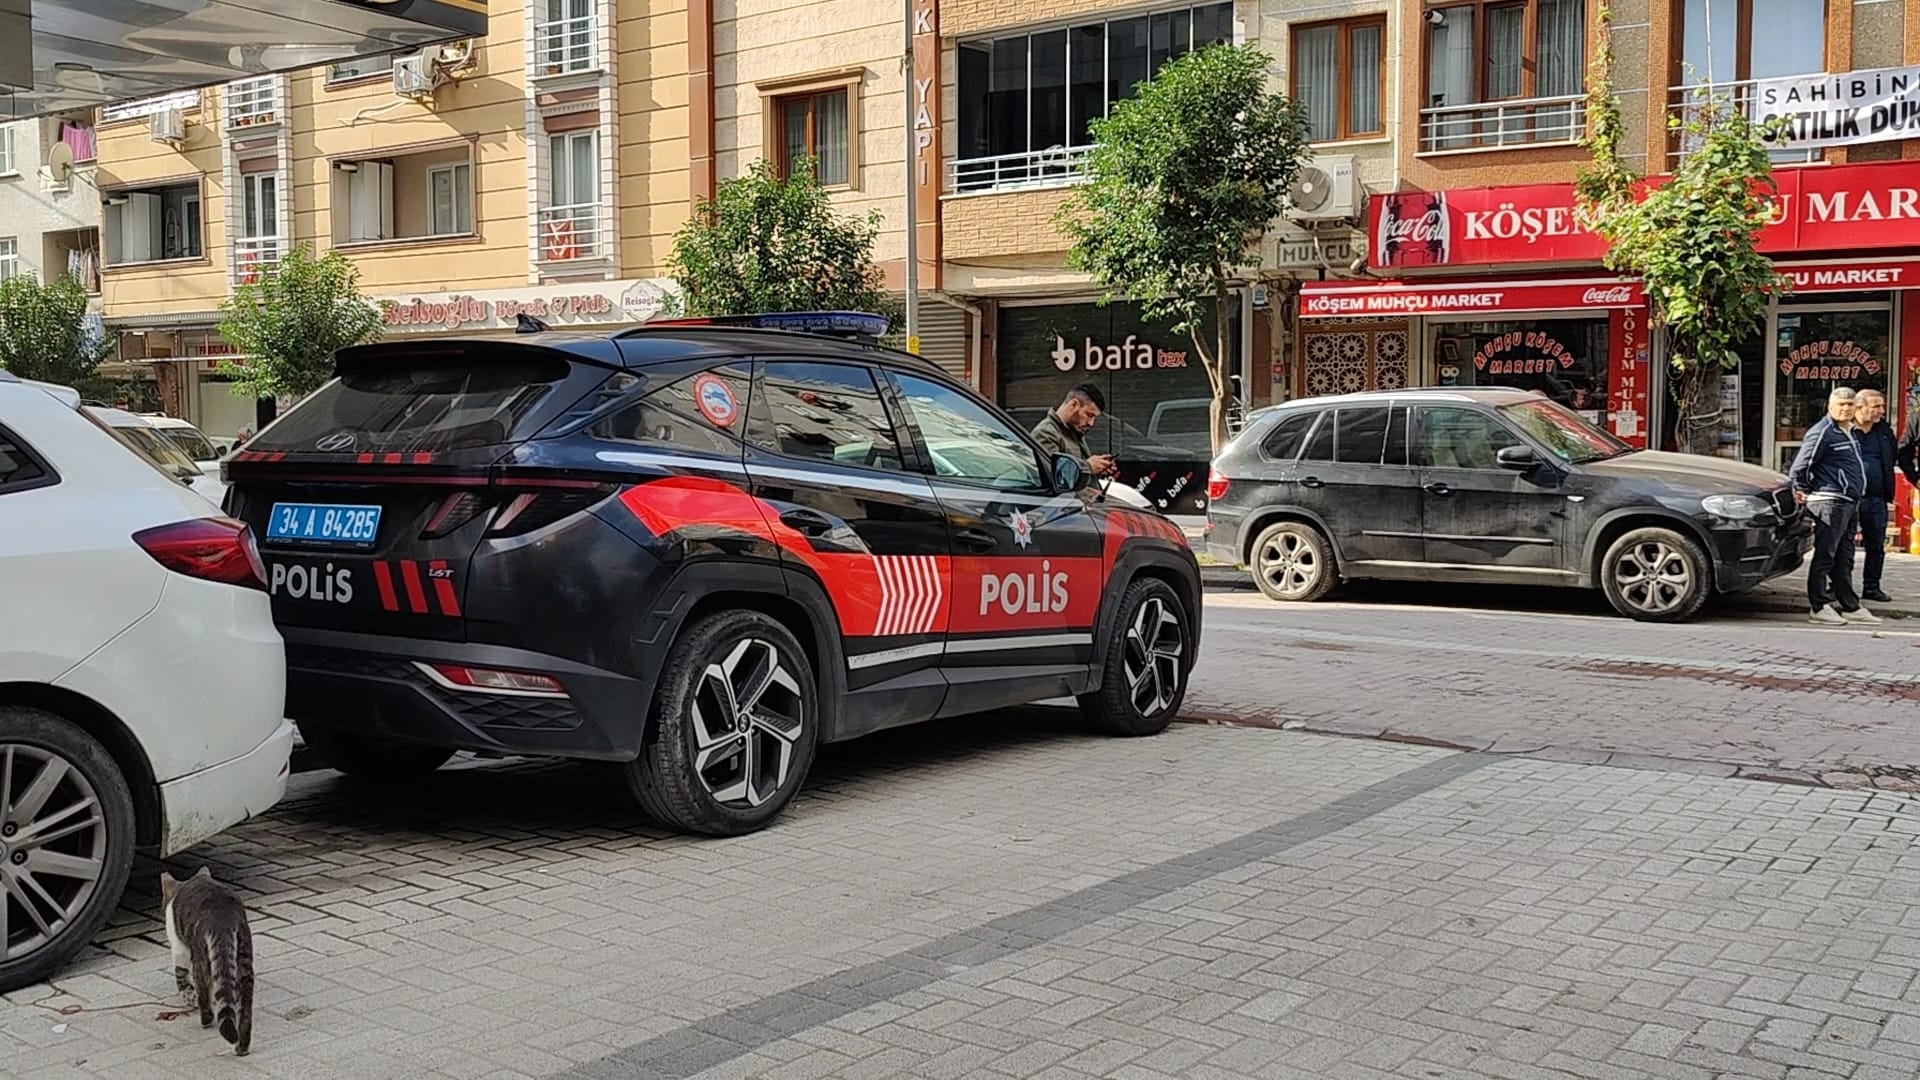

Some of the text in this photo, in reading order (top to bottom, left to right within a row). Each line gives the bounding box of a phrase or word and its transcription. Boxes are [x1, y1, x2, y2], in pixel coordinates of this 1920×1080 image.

[914, 0, 933, 185] K YAPI
[1762, 107, 1860, 142] SATILIK
[1814, 268, 1903, 285] MARKET
[569, 293, 612, 314] Pide
[1308, 293, 1504, 313] KÖŞEM MUHÇU MARKET
[1085, 335, 1187, 370] bafa tex
[1473, 331, 1575, 370] MUHÇU KÖŞEM
[1622, 308, 1636, 371] KÖŞEM
[1489, 360, 1555, 374] MARKET
[1780, 340, 1881, 376] MUHÇU KÖŞEM
[1795, 365, 1861, 379] MARKET
[279, 507, 376, 539] 34 A 84285
[979, 559, 1069, 615] POLİS
